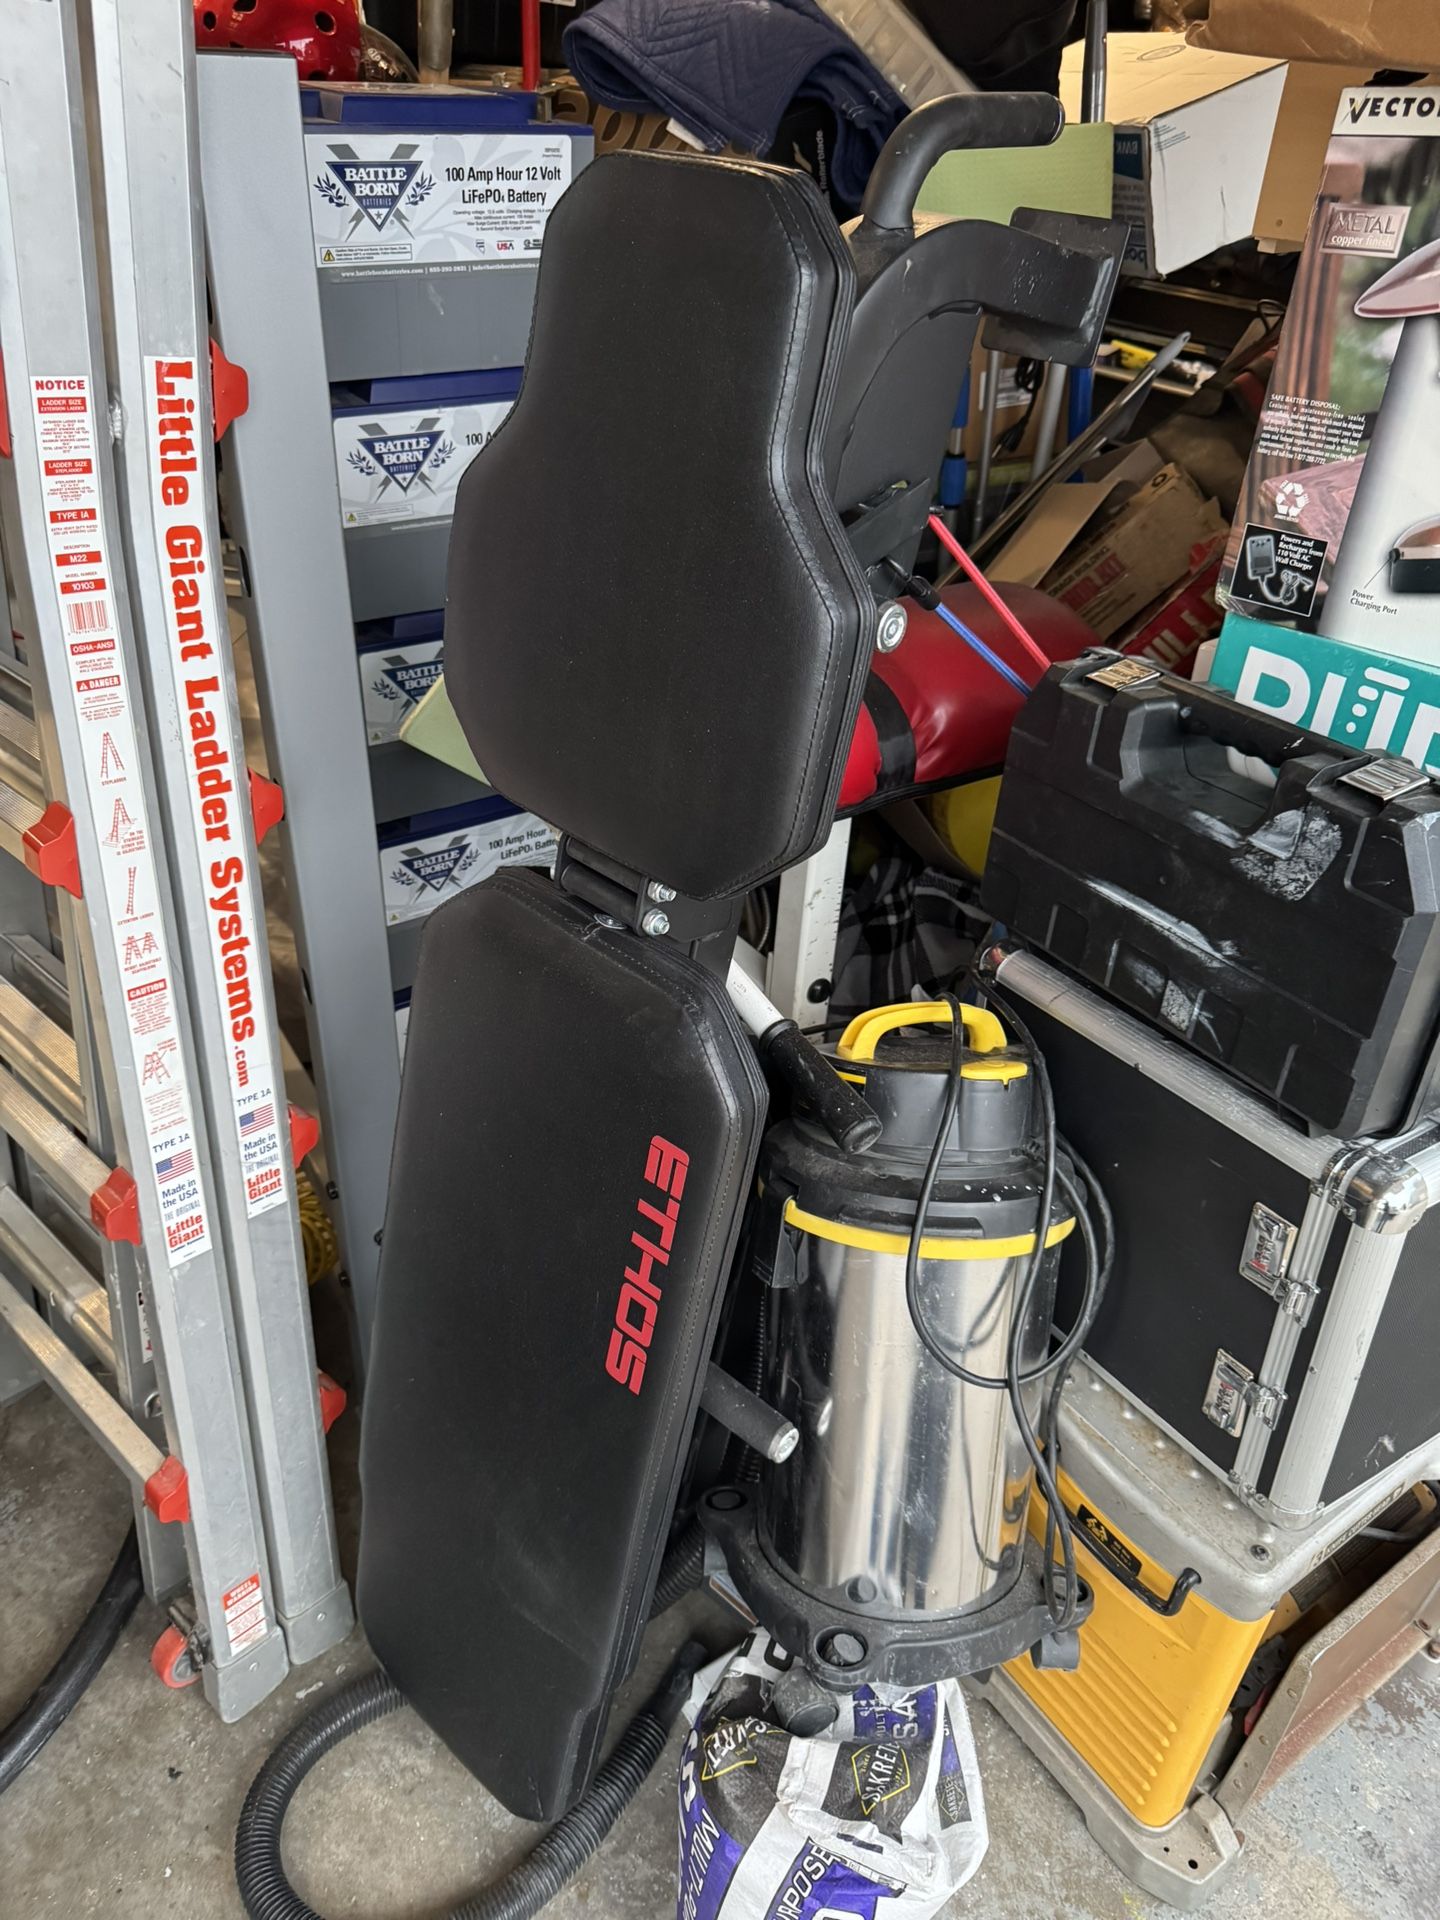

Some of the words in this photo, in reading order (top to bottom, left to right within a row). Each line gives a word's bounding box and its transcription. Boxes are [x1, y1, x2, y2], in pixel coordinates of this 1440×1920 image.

[1349, 97, 1440, 123] VECTO
[345, 167, 407, 181] BATTLE
[445, 167, 465, 182] 100
[468, 167, 493, 184] Amp
[496, 166, 522, 180] Hour
[526, 167, 538, 180] 12
[540, 166, 561, 180] Volt
[355, 183, 400, 197] BORN
[508, 189, 546, 205] Battery
[1336, 212, 1395, 234] METAL
[496, 242, 514, 250] USA
[1332, 235, 1363, 247] copper
[1365, 236, 1393, 247] finish
[35, 380, 85, 390] NOTICE
[1285, 396, 1309, 405] BATTERY
[156, 361, 197, 506] Little
[466, 434, 483, 446] 100
[373, 437, 430, 454] BATTLE
[383, 452, 423, 465] BORN
[57, 512, 78, 520] TYPE
[1281, 534, 1301, 544] Powers
[1279, 542, 1308, 553] Recharges
[1309, 548, 1323, 557] from
[70, 554, 87, 562] M22
[1276, 556, 1289, 564] Wall
[1290, 560, 1313, 570] Charger
[72, 582, 94, 590] 10103
[166, 525, 214, 662] Giant
[1352, 590, 1374, 601] Power
[1350, 598, 1380, 612] Charging
[1383, 605, 1397, 615] Port
[73, 641, 113, 653] OSHA-ANSI
[90, 677, 119, 689] DANGER
[185, 676, 232, 842] Ladder
[488, 839, 503, 850] 100
[506, 834, 525, 848] Amp
[527, 828, 547, 842] Hour
[535, 839, 556, 852] Batte
[413, 850, 460, 868] BATTLE
[419, 860, 456, 875] BORN
[130, 982, 164, 998] CAUTION
[237, 1093, 258, 1106] TYPE
[261, 1088, 271, 1097] 1A
[153, 1139, 176, 1153] TYPE
[178, 1133, 190, 1143] 1A
[244, 1138, 267, 1151] Made
[244, 1152, 258, 1161] the
[260, 1142, 278, 1154] USA
[247, 1167, 281, 1189] Little
[162, 1183, 186, 1198] Made
[188, 1179, 196, 1188] in
[249, 1178, 282, 1200] Giant
[163, 1199, 177, 1209] the
[178, 1189, 198, 1202] USA
[167, 1214, 203, 1237] Little
[170, 1224, 204, 1248] Giant
[605, 1135, 690, 1395] ETHOS
